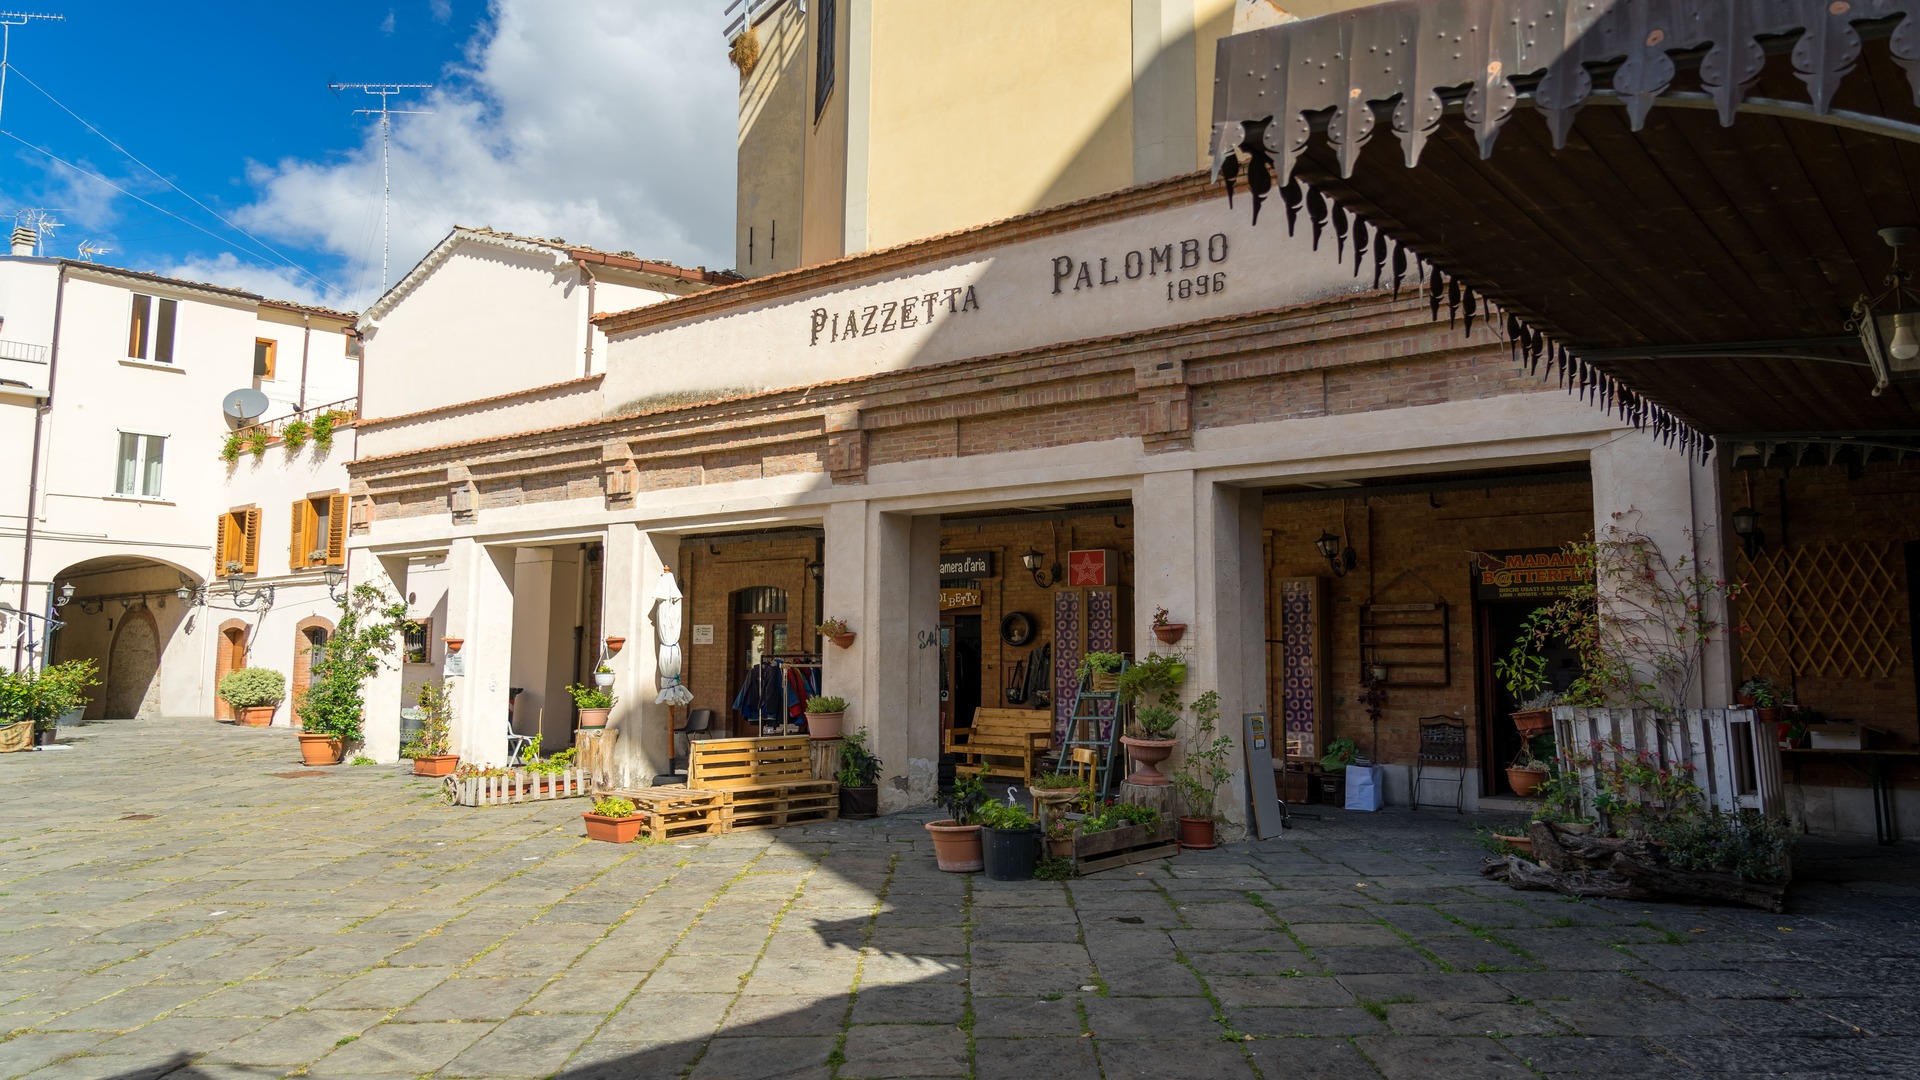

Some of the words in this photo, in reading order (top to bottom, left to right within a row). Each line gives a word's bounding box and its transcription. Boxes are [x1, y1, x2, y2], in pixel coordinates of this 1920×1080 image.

[809, 284, 980, 347] PIAZZETTA
[1051, 233, 1229, 294] PALOMBO
[1166, 271, 1227, 301] 1896
[940, 562, 963, 574] amera
[964, 557, 986, 572] d'aria
[948, 592, 978, 606] BETTY
